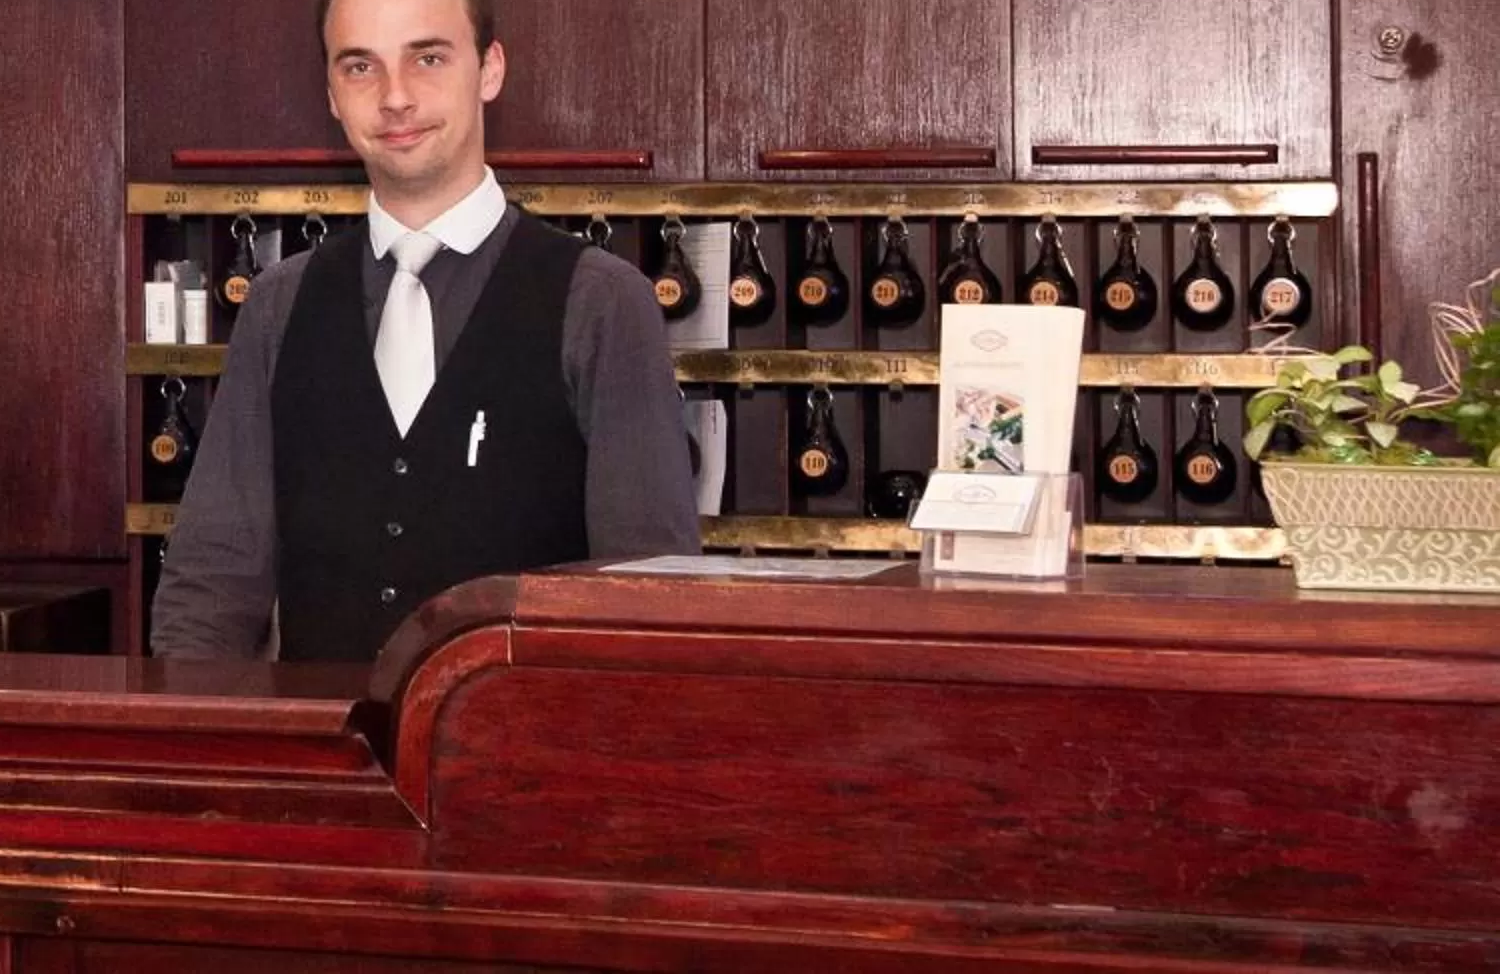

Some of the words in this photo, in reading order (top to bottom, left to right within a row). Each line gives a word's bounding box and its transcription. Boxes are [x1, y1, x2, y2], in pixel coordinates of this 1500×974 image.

[164, 191, 188, 204] 201
[233, 191, 260, 204] 202
[957, 288, 980, 301] 212
[1269, 290, 1293, 304] 217
[885, 359, 908, 373] 111
[1191, 462, 1214, 475] 116
